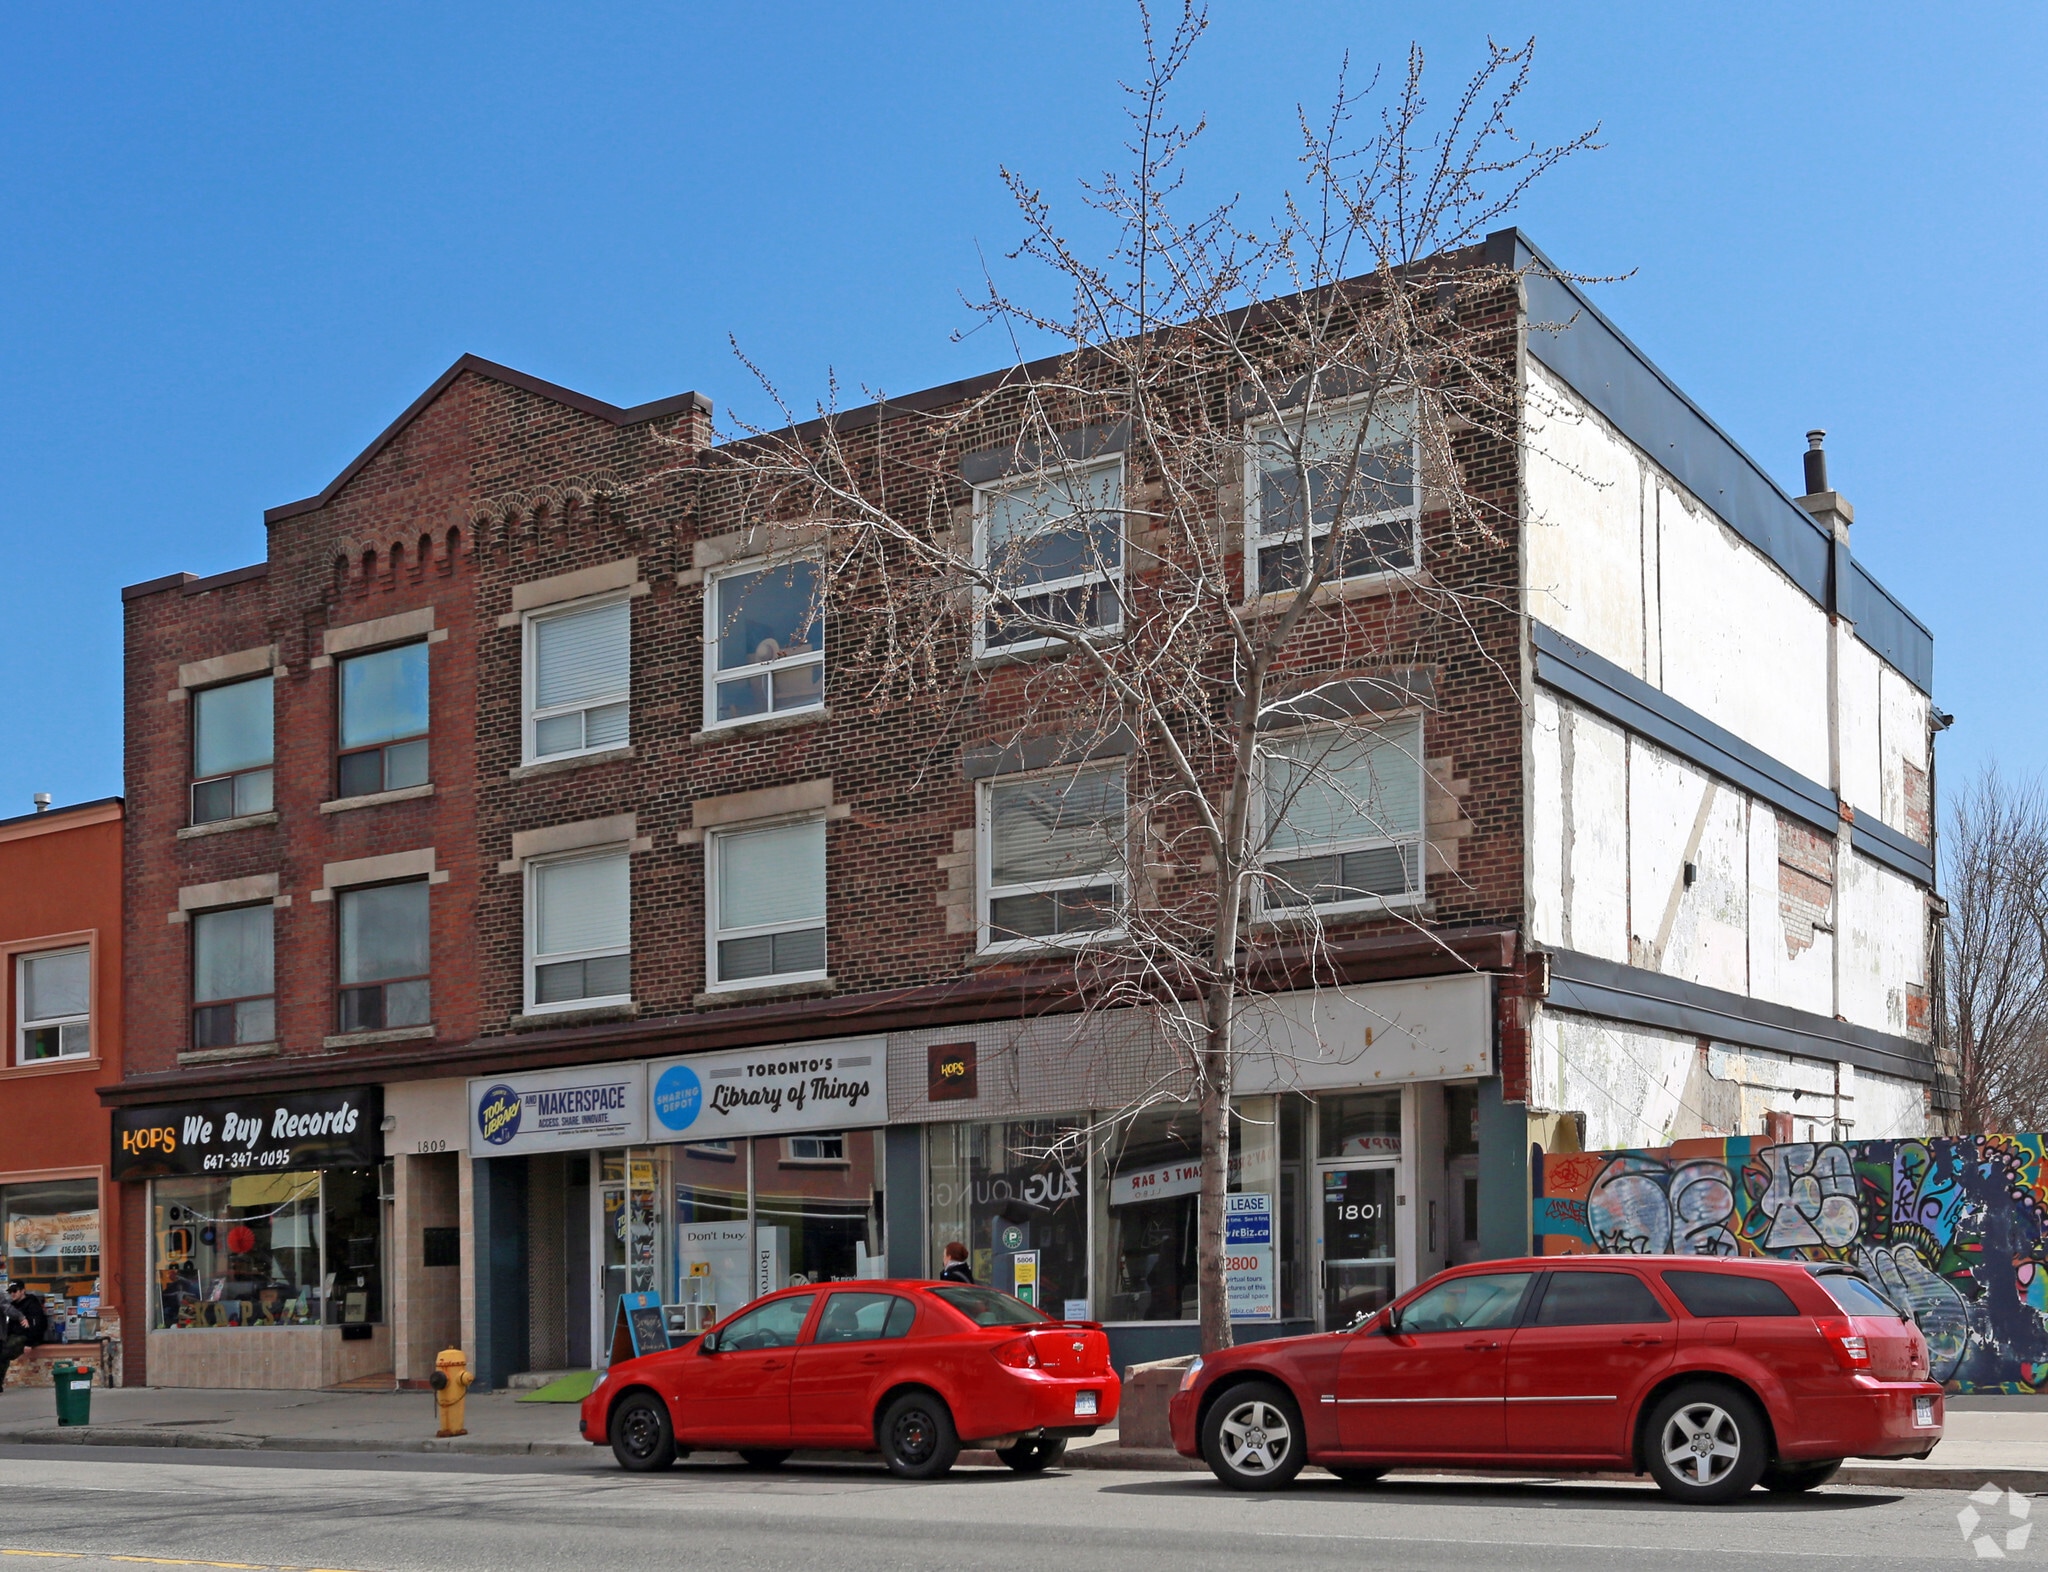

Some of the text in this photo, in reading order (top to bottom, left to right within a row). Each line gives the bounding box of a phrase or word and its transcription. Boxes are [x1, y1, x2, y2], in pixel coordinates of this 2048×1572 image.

[747, 1058, 833, 1077] TORONTO'S
[941, 1061, 965, 1078] KOPS
[525, 1086, 625, 1116] AND MAKERSPACE
[657, 1086, 699, 1106] SHARING
[710, 1076, 870, 1115] Library of Things
[483, 1097, 506, 1122] TOOL
[663, 1099, 693, 1114] DEPOT
[123, 1101, 359, 1155] KOPS We Buy Records
[484, 1099, 522, 1140] LIBRARY
[538, 1113, 610, 1129] ACCESS. SHARE. INNOVATE.
[417, 1139, 446, 1153] 1809
[203, 1149, 290, 1170] 647-347-0095
[1231, 1198, 1264, 1210] LEASE
[1337, 1204, 1382, 1220] 1801
[57, 1214, 92, 1224] National
[61, 1222, 99, 1232] Automotiv
[62, 1232, 86, 1242] Supply
[688, 1231, 747, 1242] Don't buy.
[195, 1301, 275, 1327] KOPS
